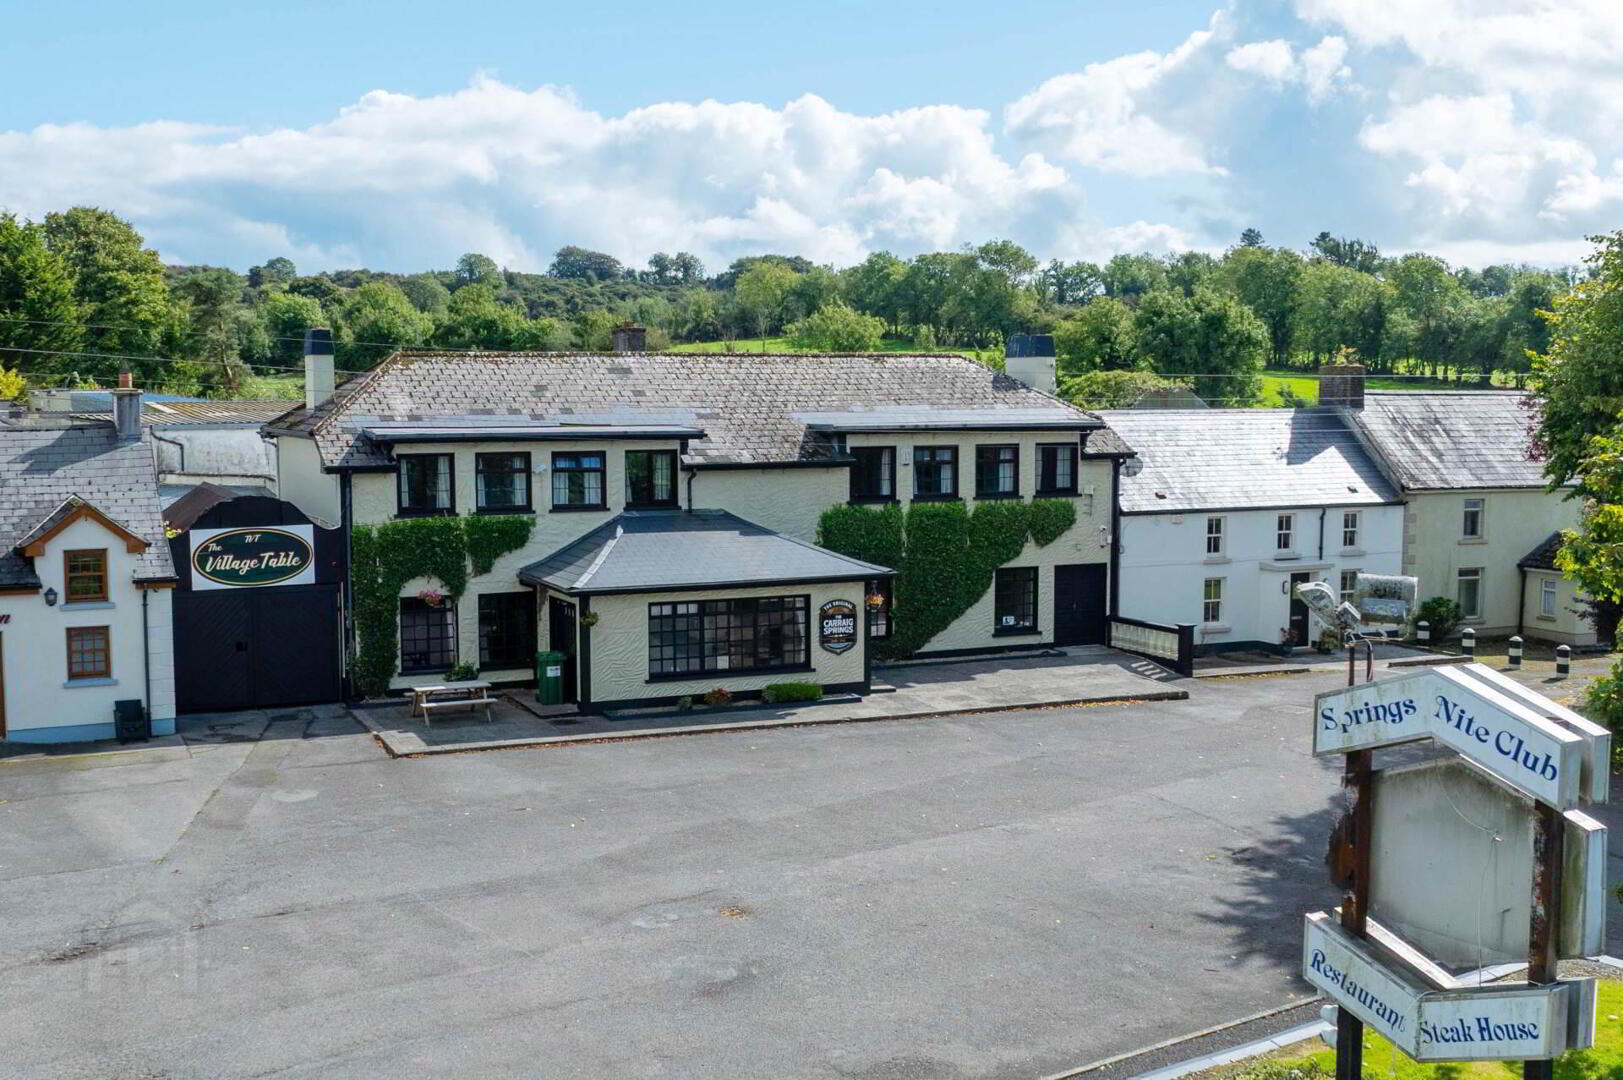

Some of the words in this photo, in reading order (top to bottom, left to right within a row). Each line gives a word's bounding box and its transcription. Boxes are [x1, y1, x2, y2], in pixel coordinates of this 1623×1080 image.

[207, 543, 222, 552] The
[205, 555, 259, 575] Village
[259, 551, 302, 569] Table
[823, 618, 853, 627] CARRAIG
[823, 626, 853, 635] SPRINGS
[1320, 698, 1417, 734] Springs
[1433, 695, 1490, 743] Nite
[1495, 730, 1558, 781] Club
[1419, 1017, 1475, 1044] Steak
[1475, 1016, 1539, 1042] House
